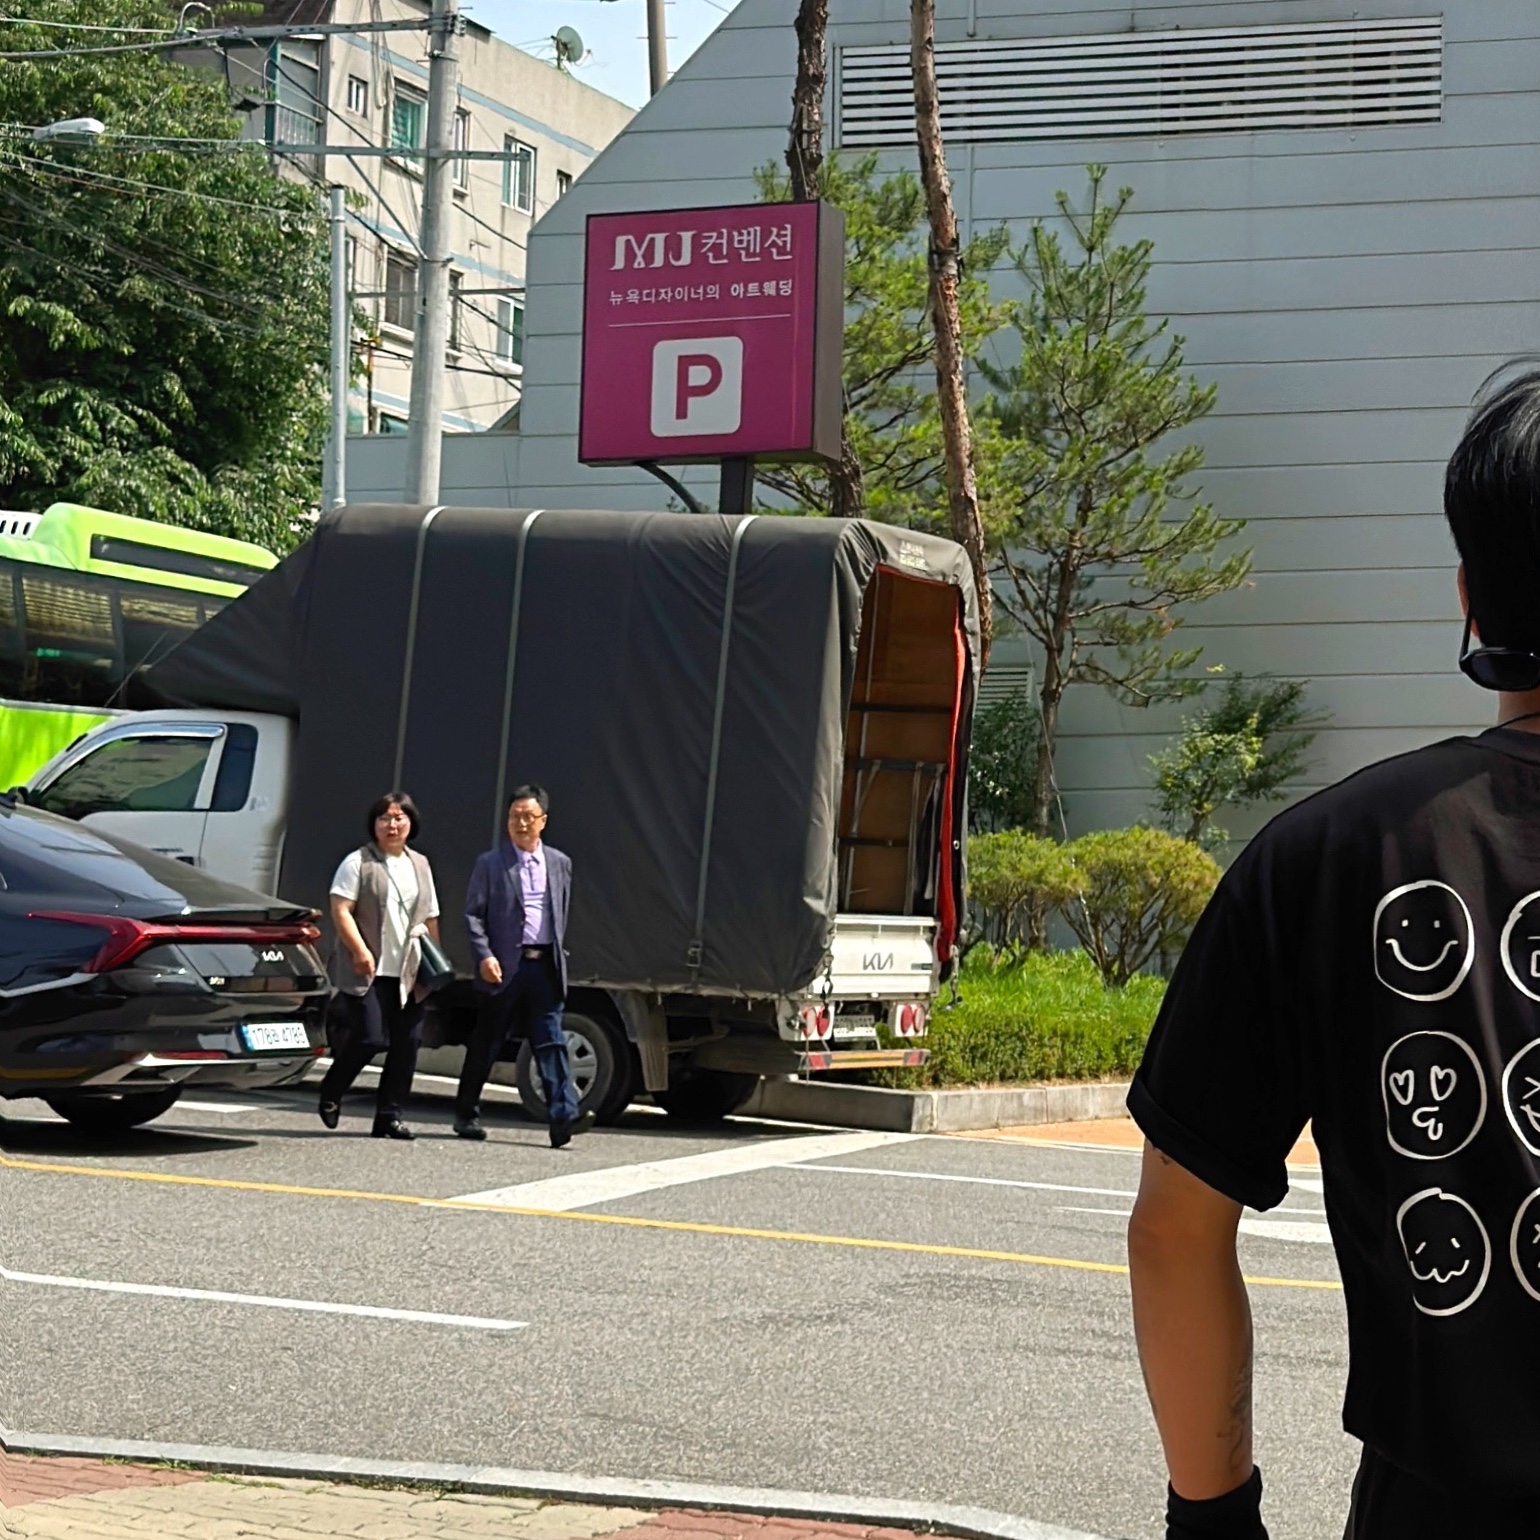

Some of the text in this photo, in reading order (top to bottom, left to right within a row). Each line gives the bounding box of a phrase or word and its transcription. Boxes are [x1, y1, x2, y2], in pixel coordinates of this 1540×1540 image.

[608, 279, 794, 306] 뉴욕디자이너의 아트웨딩
[675, 353, 723, 421] P
